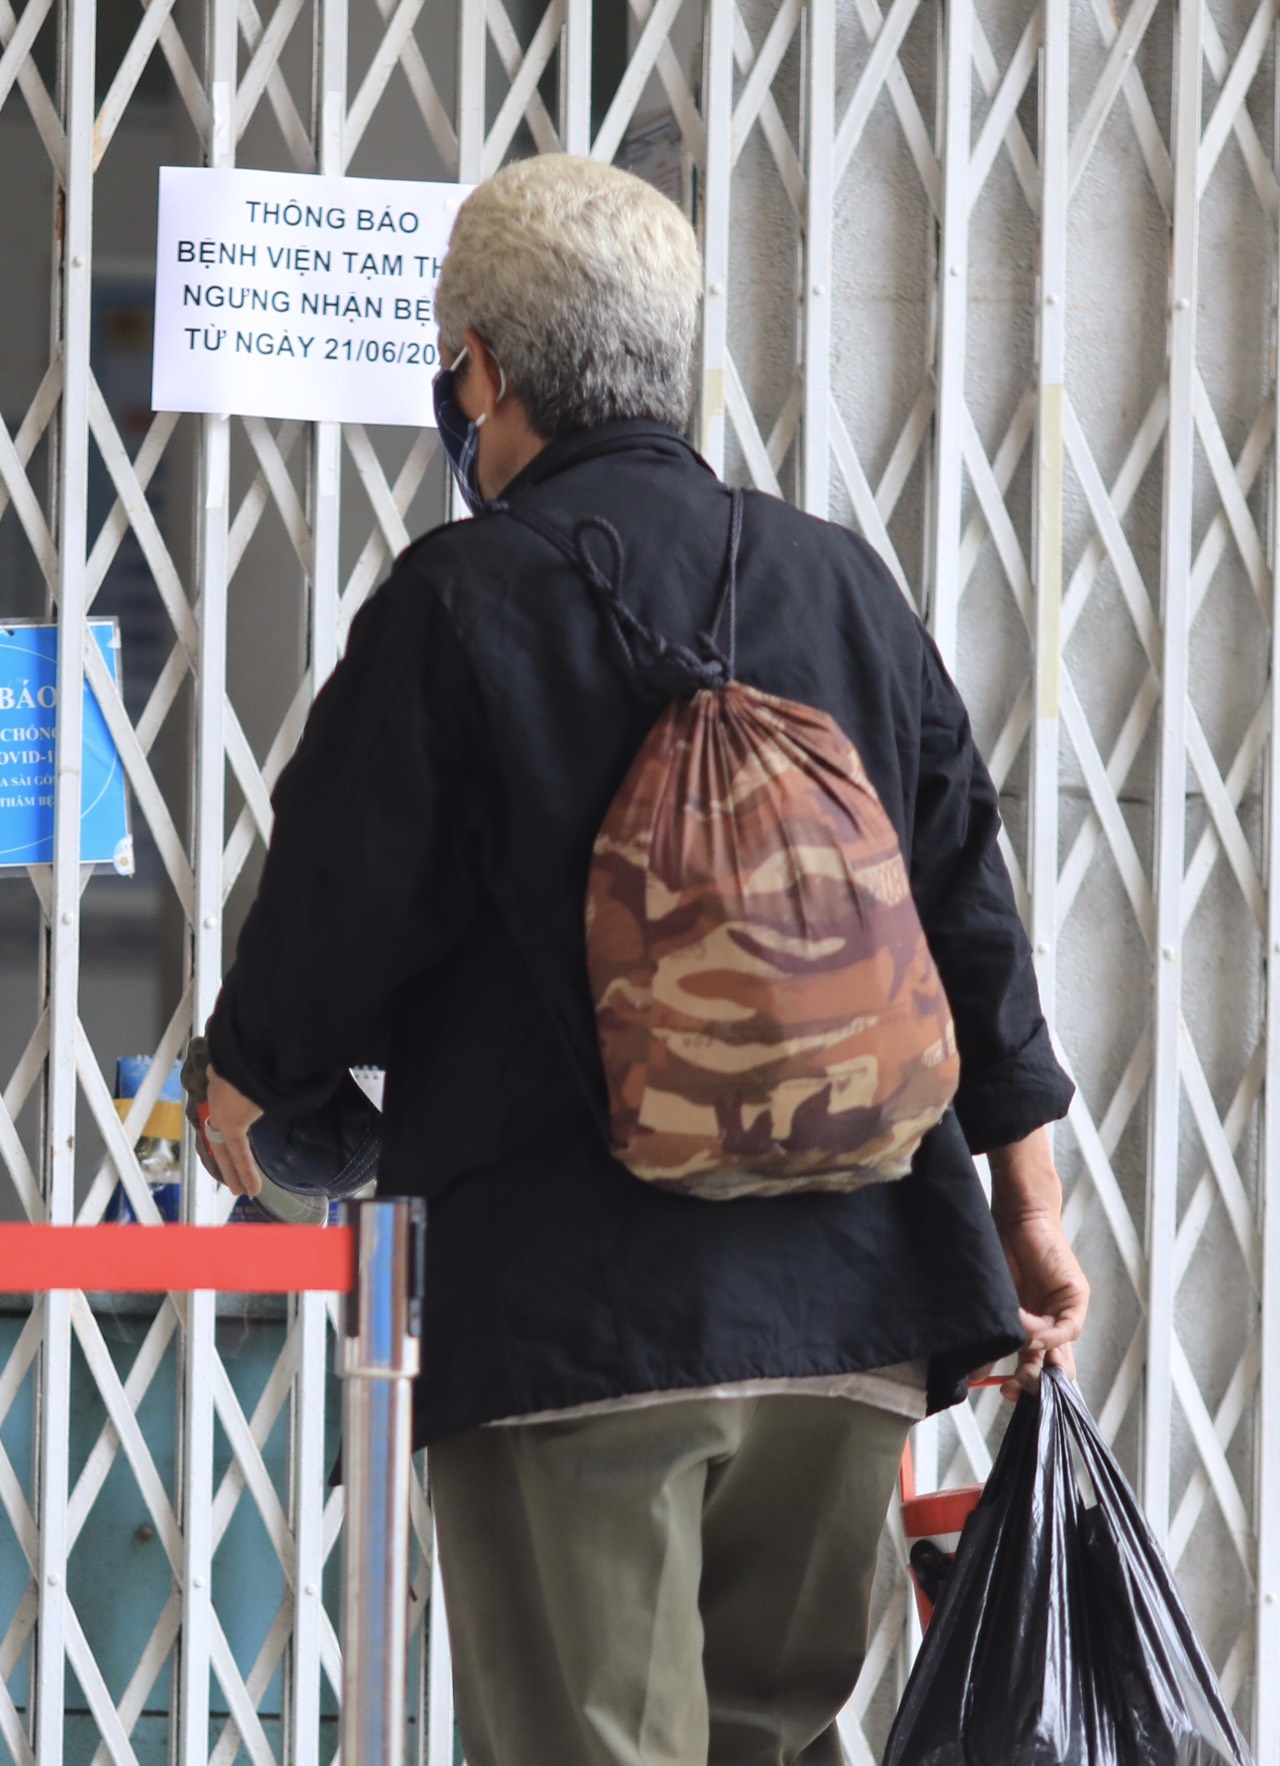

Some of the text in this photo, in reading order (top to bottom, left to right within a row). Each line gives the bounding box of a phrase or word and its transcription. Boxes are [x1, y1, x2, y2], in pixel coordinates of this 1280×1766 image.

[245, 198, 419, 234] THÔNG BÁO
[177, 237, 442, 281] BỆNH VIỆN TẠM TH
[183, 284, 431, 327] NGƯNG NHẬN BỆ
[183, 322, 441, 367] TỪ NGÀY 21/06/20
